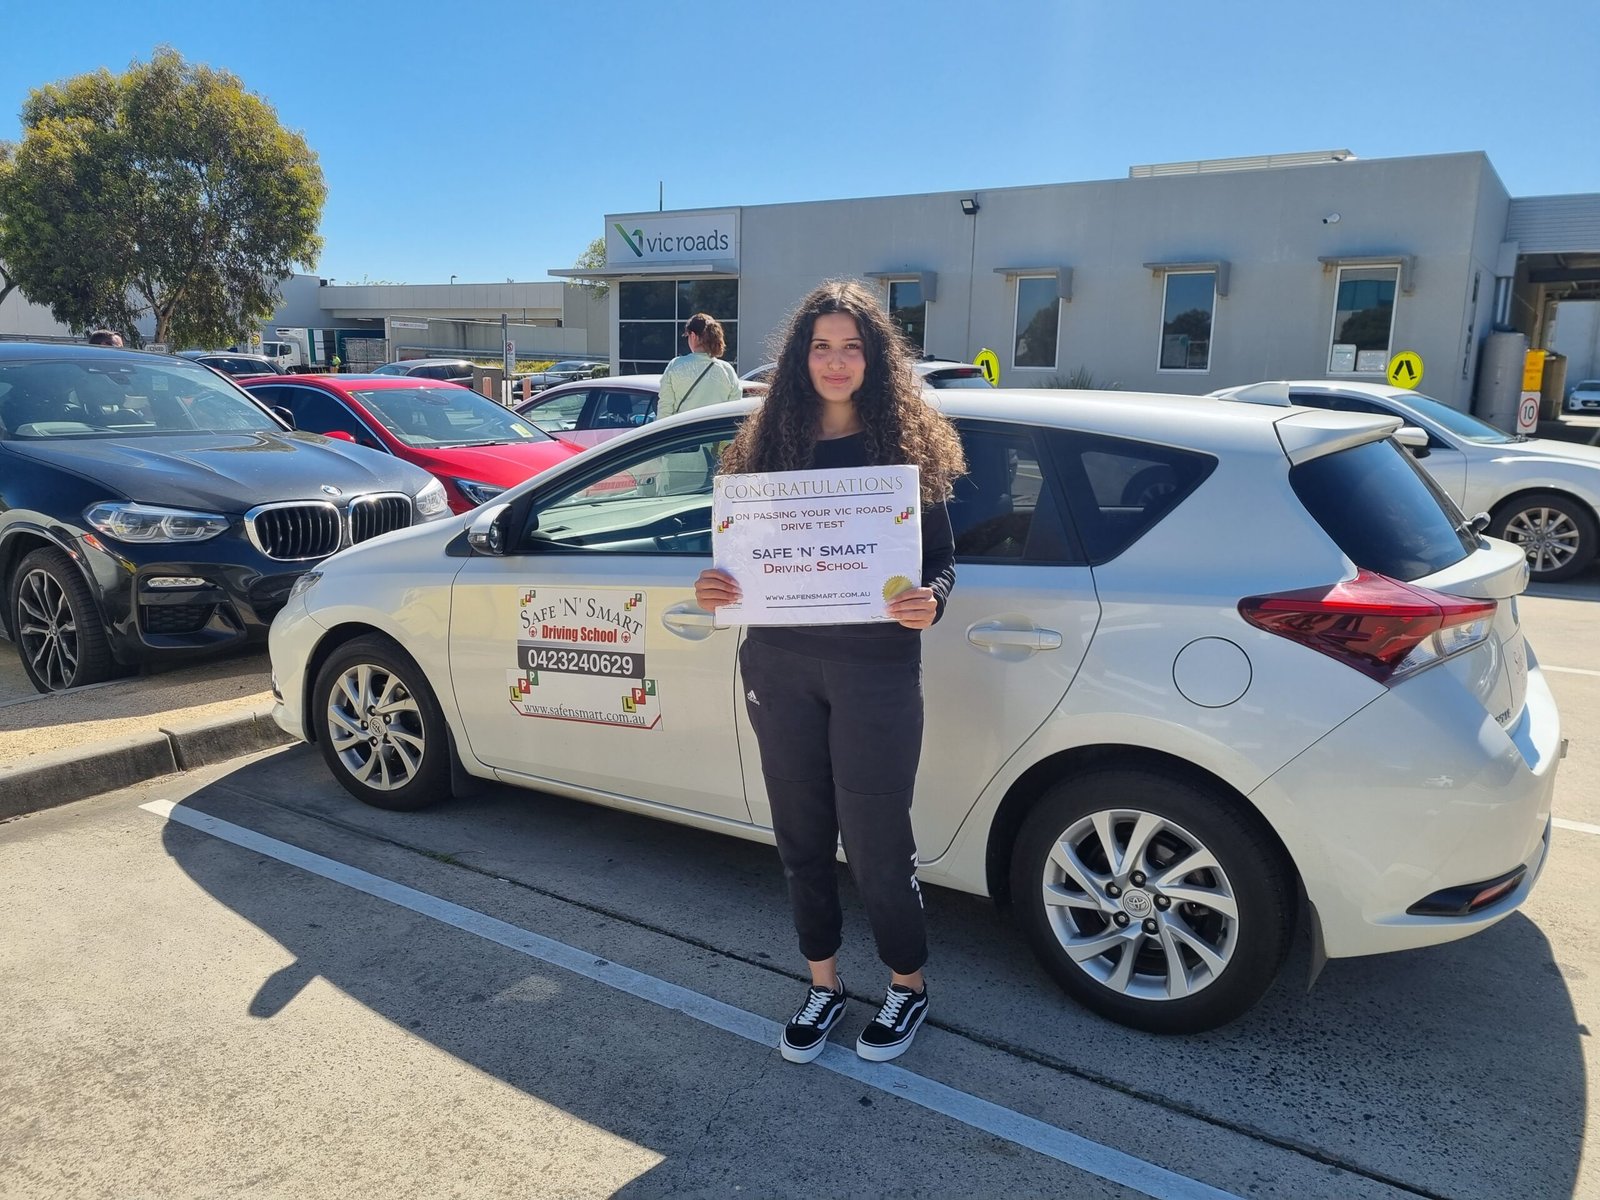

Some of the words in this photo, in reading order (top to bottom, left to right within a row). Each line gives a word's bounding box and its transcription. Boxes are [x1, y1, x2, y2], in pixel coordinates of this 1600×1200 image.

[1524, 405, 1535, 420] 10
[724, 475, 903, 499] CONGRATULATIONS
[735, 513, 750, 521] ON
[753, 511, 797, 520] PASSING
[801, 509, 830, 517] YOUR
[835, 507, 852, 516] VIC
[856, 505, 893, 514] ROADS
[781, 523, 812, 531] DRIVE
[816, 520, 845, 529] TEST
[752, 548, 792, 560] SAFE
[820, 543, 878, 556] SMART
[542, 625, 578, 642] Driving
[581, 627, 617, 643] School
[528, 650, 634, 675] 0423240629
[524, 704, 646, 725] www.safensmart.com.au
